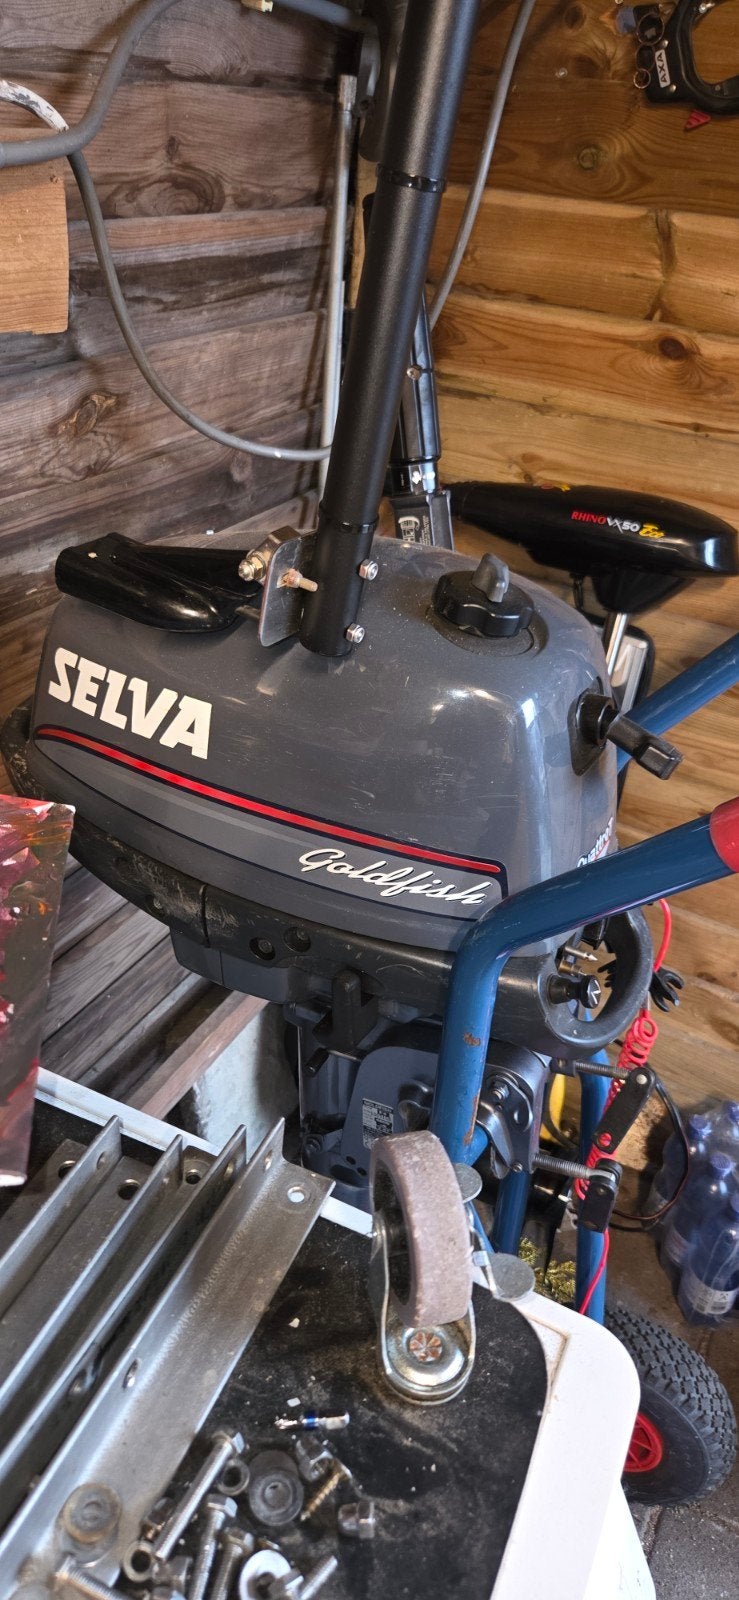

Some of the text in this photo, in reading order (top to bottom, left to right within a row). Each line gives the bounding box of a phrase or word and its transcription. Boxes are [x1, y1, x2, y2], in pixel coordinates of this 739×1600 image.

[657, 53, 668, 83] AXA
[571, 511, 606, 525] RHINO
[48, 647, 212, 760] SELVA
[298, 848, 492, 905] Goldfish
